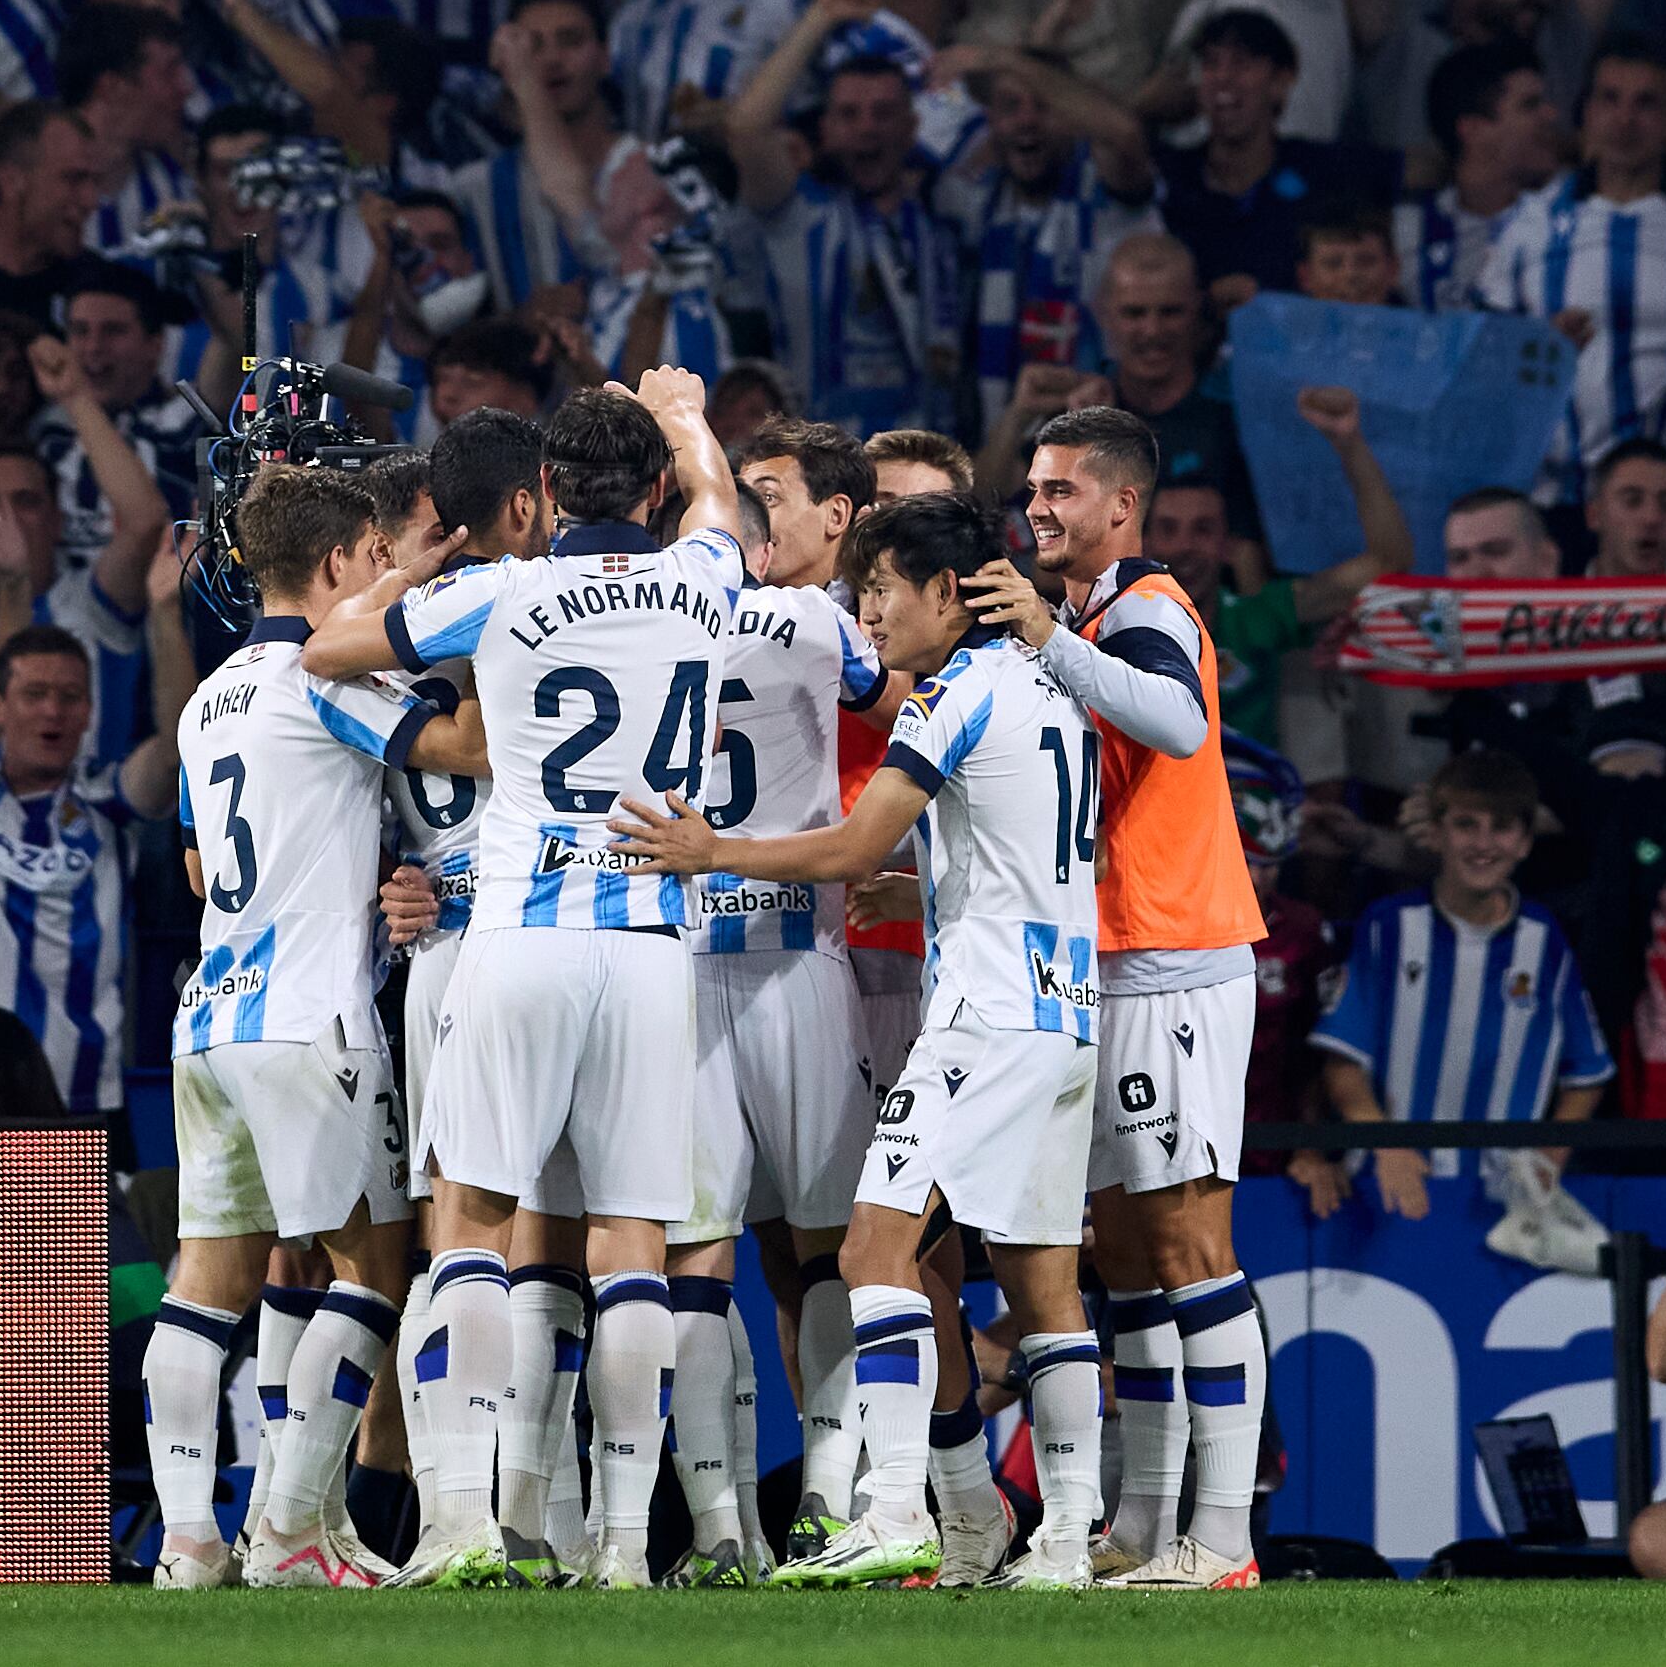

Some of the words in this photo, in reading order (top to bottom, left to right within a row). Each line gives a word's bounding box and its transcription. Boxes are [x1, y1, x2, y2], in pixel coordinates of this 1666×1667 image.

[509, 605, 558, 651] LE
[556, 581, 721, 640] NORMAND
[199, 682, 258, 732] AIHEN
[533, 659, 710, 814] 24
[1038, 726, 1099, 885] 14
[208, 752, 258, 915] 3
[700, 885, 810, 914] txabank
[373, 1090, 404, 1154] 3
[1114, 1110, 1179, 1138] finetwork
[468, 1395, 499, 1414] RS
[810, 1415, 843, 1431] RS
[169, 1444, 203, 1460] RS
[603, 1440, 636, 1456] RS
[1044, 1442, 1075, 1455] RS
[694, 1459, 724, 1474] RS
